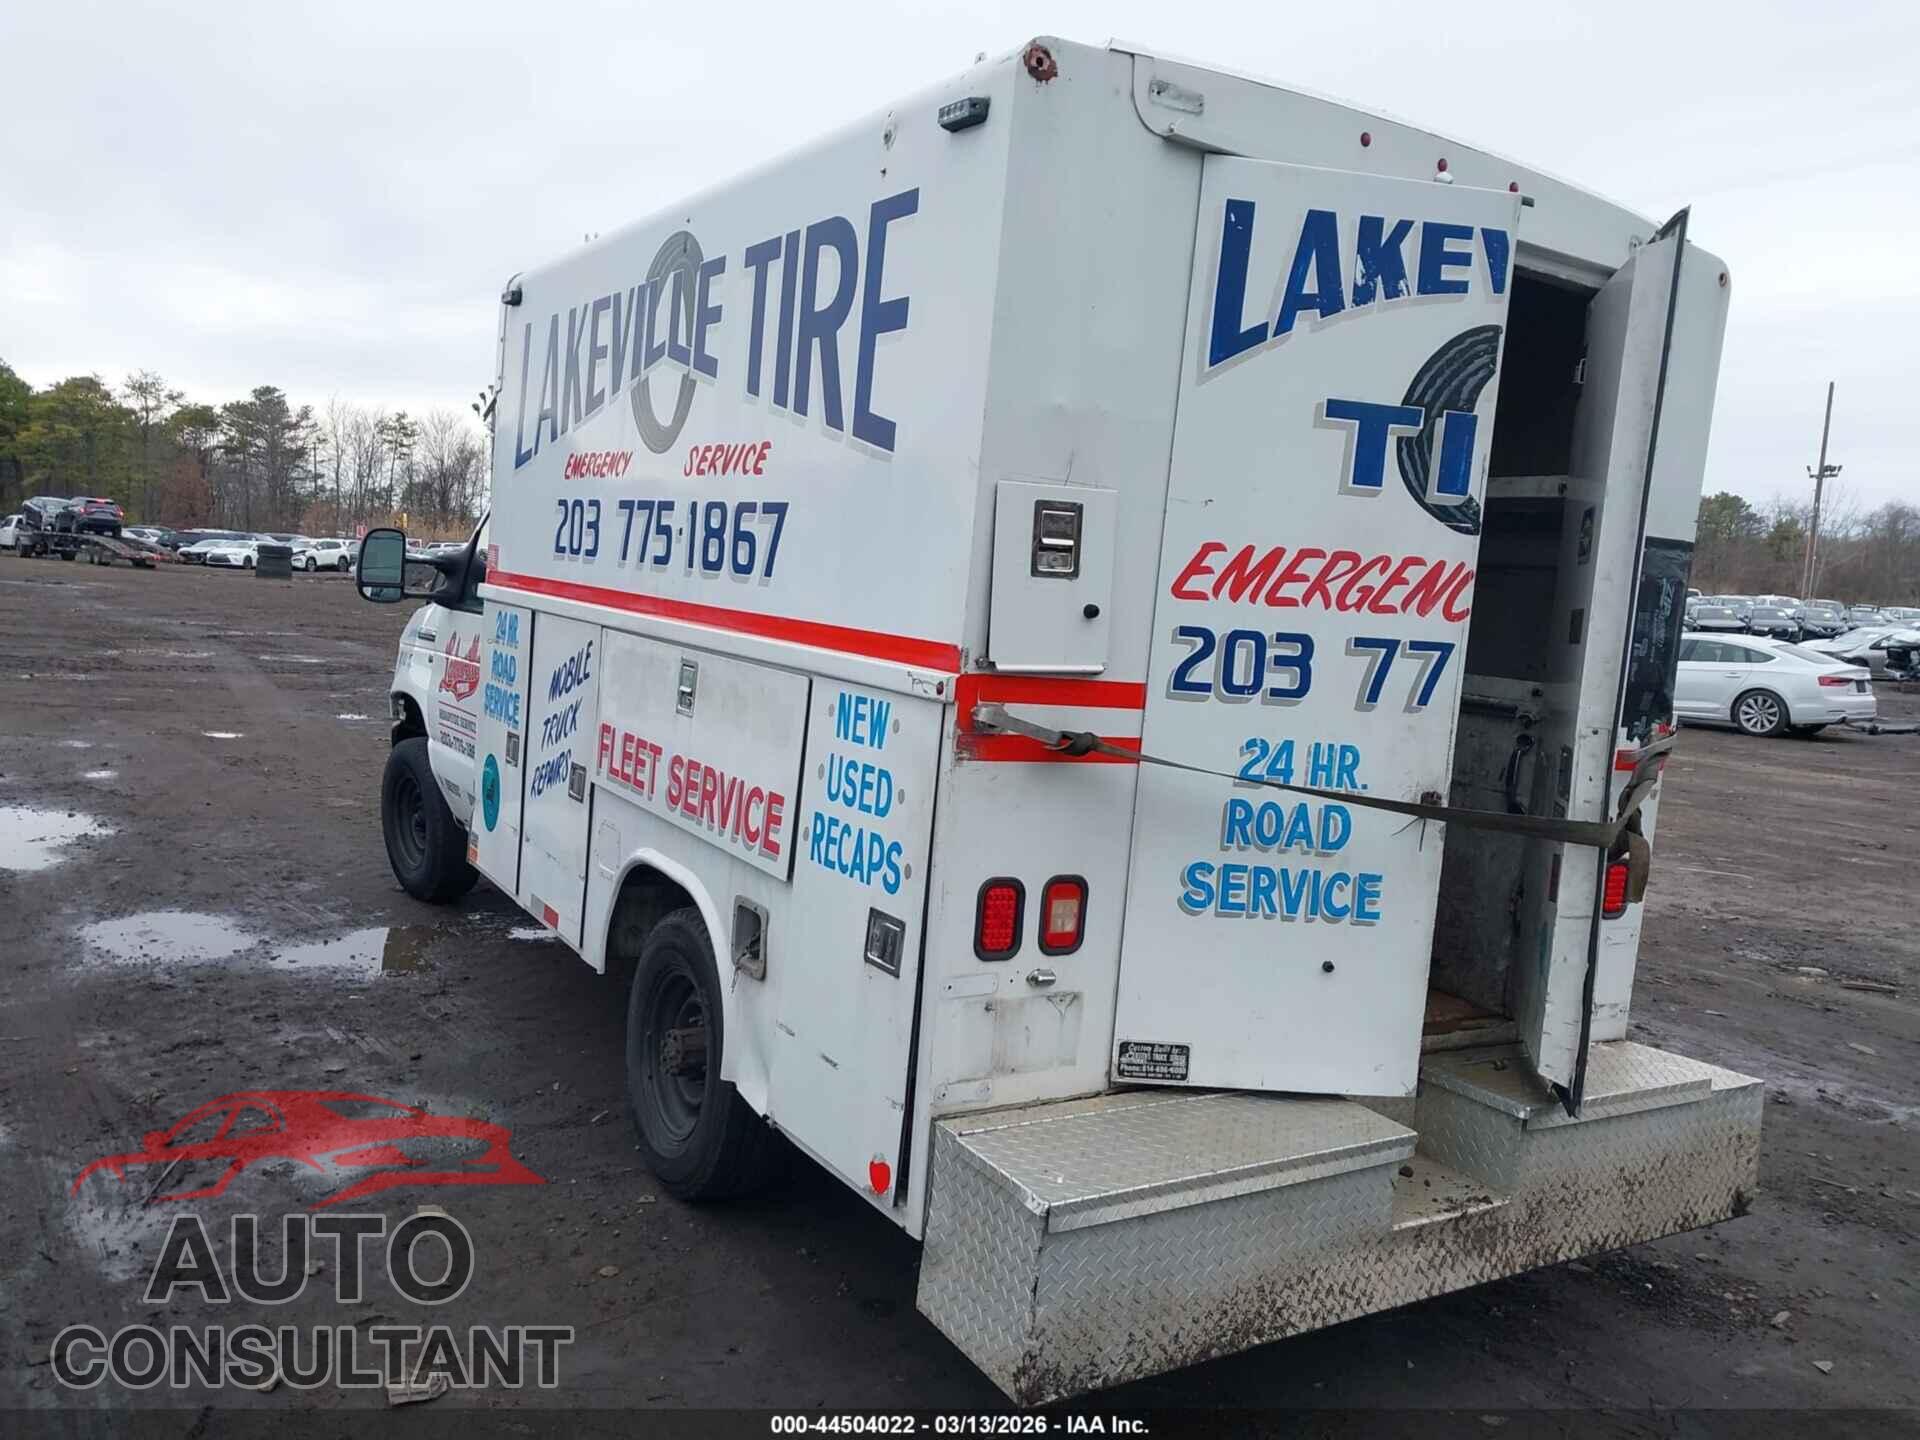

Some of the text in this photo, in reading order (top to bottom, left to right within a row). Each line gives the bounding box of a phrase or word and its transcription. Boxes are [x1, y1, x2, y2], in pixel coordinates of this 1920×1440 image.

[514, 187, 920, 470] LAKEVILLE TIRE
[564, 441, 772, 480] EMERGENCY SERVICE
[1323, 397, 1479, 497] TI
[554, 499, 600, 558] 203
[1170, 541, 1475, 623] EMERGENC
[491, 649, 517, 683] ROAD
[548, 640, 594, 703] MOBILE
[1169, 625, 1456, 709] 203 77
[485, 683, 520, 726] SERVICE
[541, 696, 583, 752] TRUCK
[836, 692, 891, 749] NEW
[531, 749, 572, 799] REPAIRS
[598, 723, 785, 857] FLEET SERVICE
[826, 752, 893, 818] USED
[1236, 738, 1369, 791] 24 HR.
[810, 811, 903, 895] RECAPS
[1224, 798, 1352, 852] ROAD
[1181, 861, 1383, 922] SERVICE
